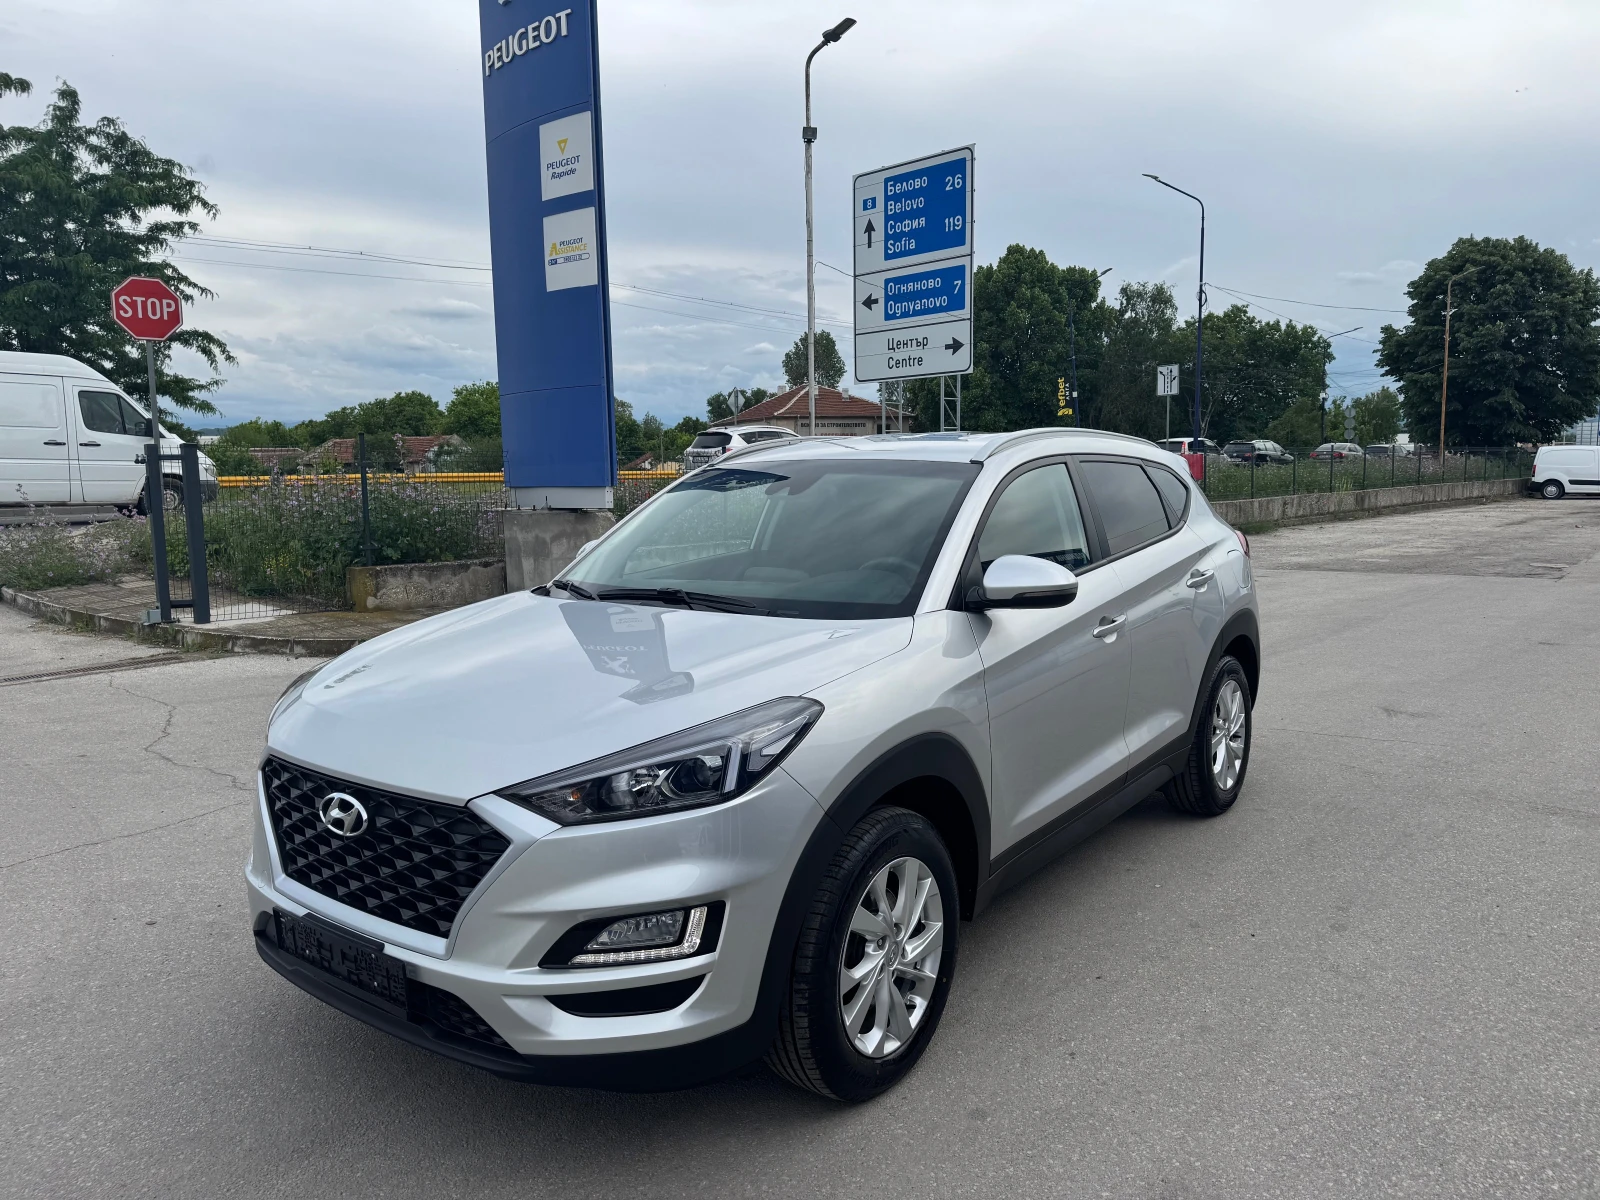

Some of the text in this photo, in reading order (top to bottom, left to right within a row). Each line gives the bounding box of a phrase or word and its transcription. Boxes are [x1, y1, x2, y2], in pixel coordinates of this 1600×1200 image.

[485, 8, 572, 76] PEUGEOT
[546, 155, 580, 171] PEUGEOT
[551, 168, 577, 180] Rapide
[887, 174, 963, 196] Белово 26
[866, 199, 873, 209] 8
[887, 197, 925, 215] Belovo
[887, 215, 963, 235] София 119
[559, 237, 583, 247] PEUGEOT
[887, 237, 916, 254] Sofia
[887, 278, 962, 296] Огняново 7
[118, 295, 176, 320] STOP
[887, 296, 948, 317] Ognyanovo
[887, 336, 928, 353] Център
[887, 355, 923, 369] Centre
[1057, 377, 1065, 406] efbet
